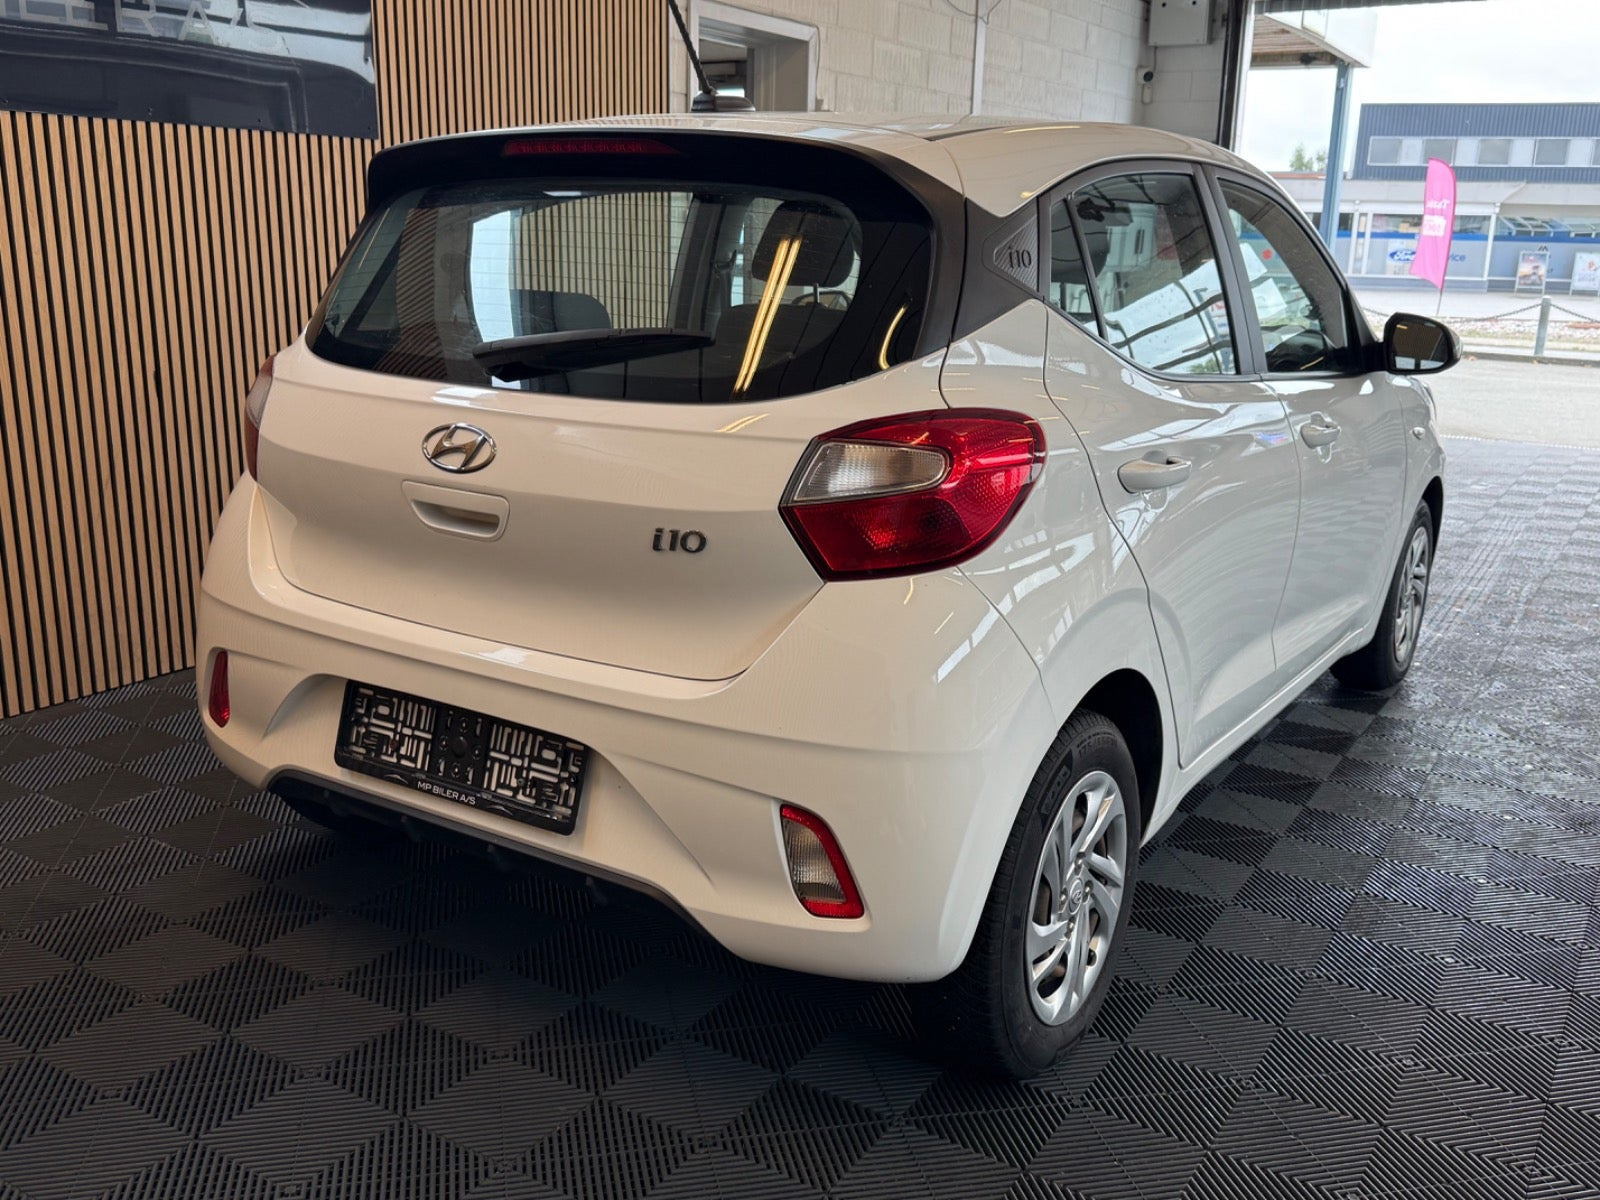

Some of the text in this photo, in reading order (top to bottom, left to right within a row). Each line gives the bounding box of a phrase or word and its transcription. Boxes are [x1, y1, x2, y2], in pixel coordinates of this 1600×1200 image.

[1008, 245, 1032, 269] i10
[652, 527, 707, 553] i10
[417, 781, 476, 805] MP BILER A/S
